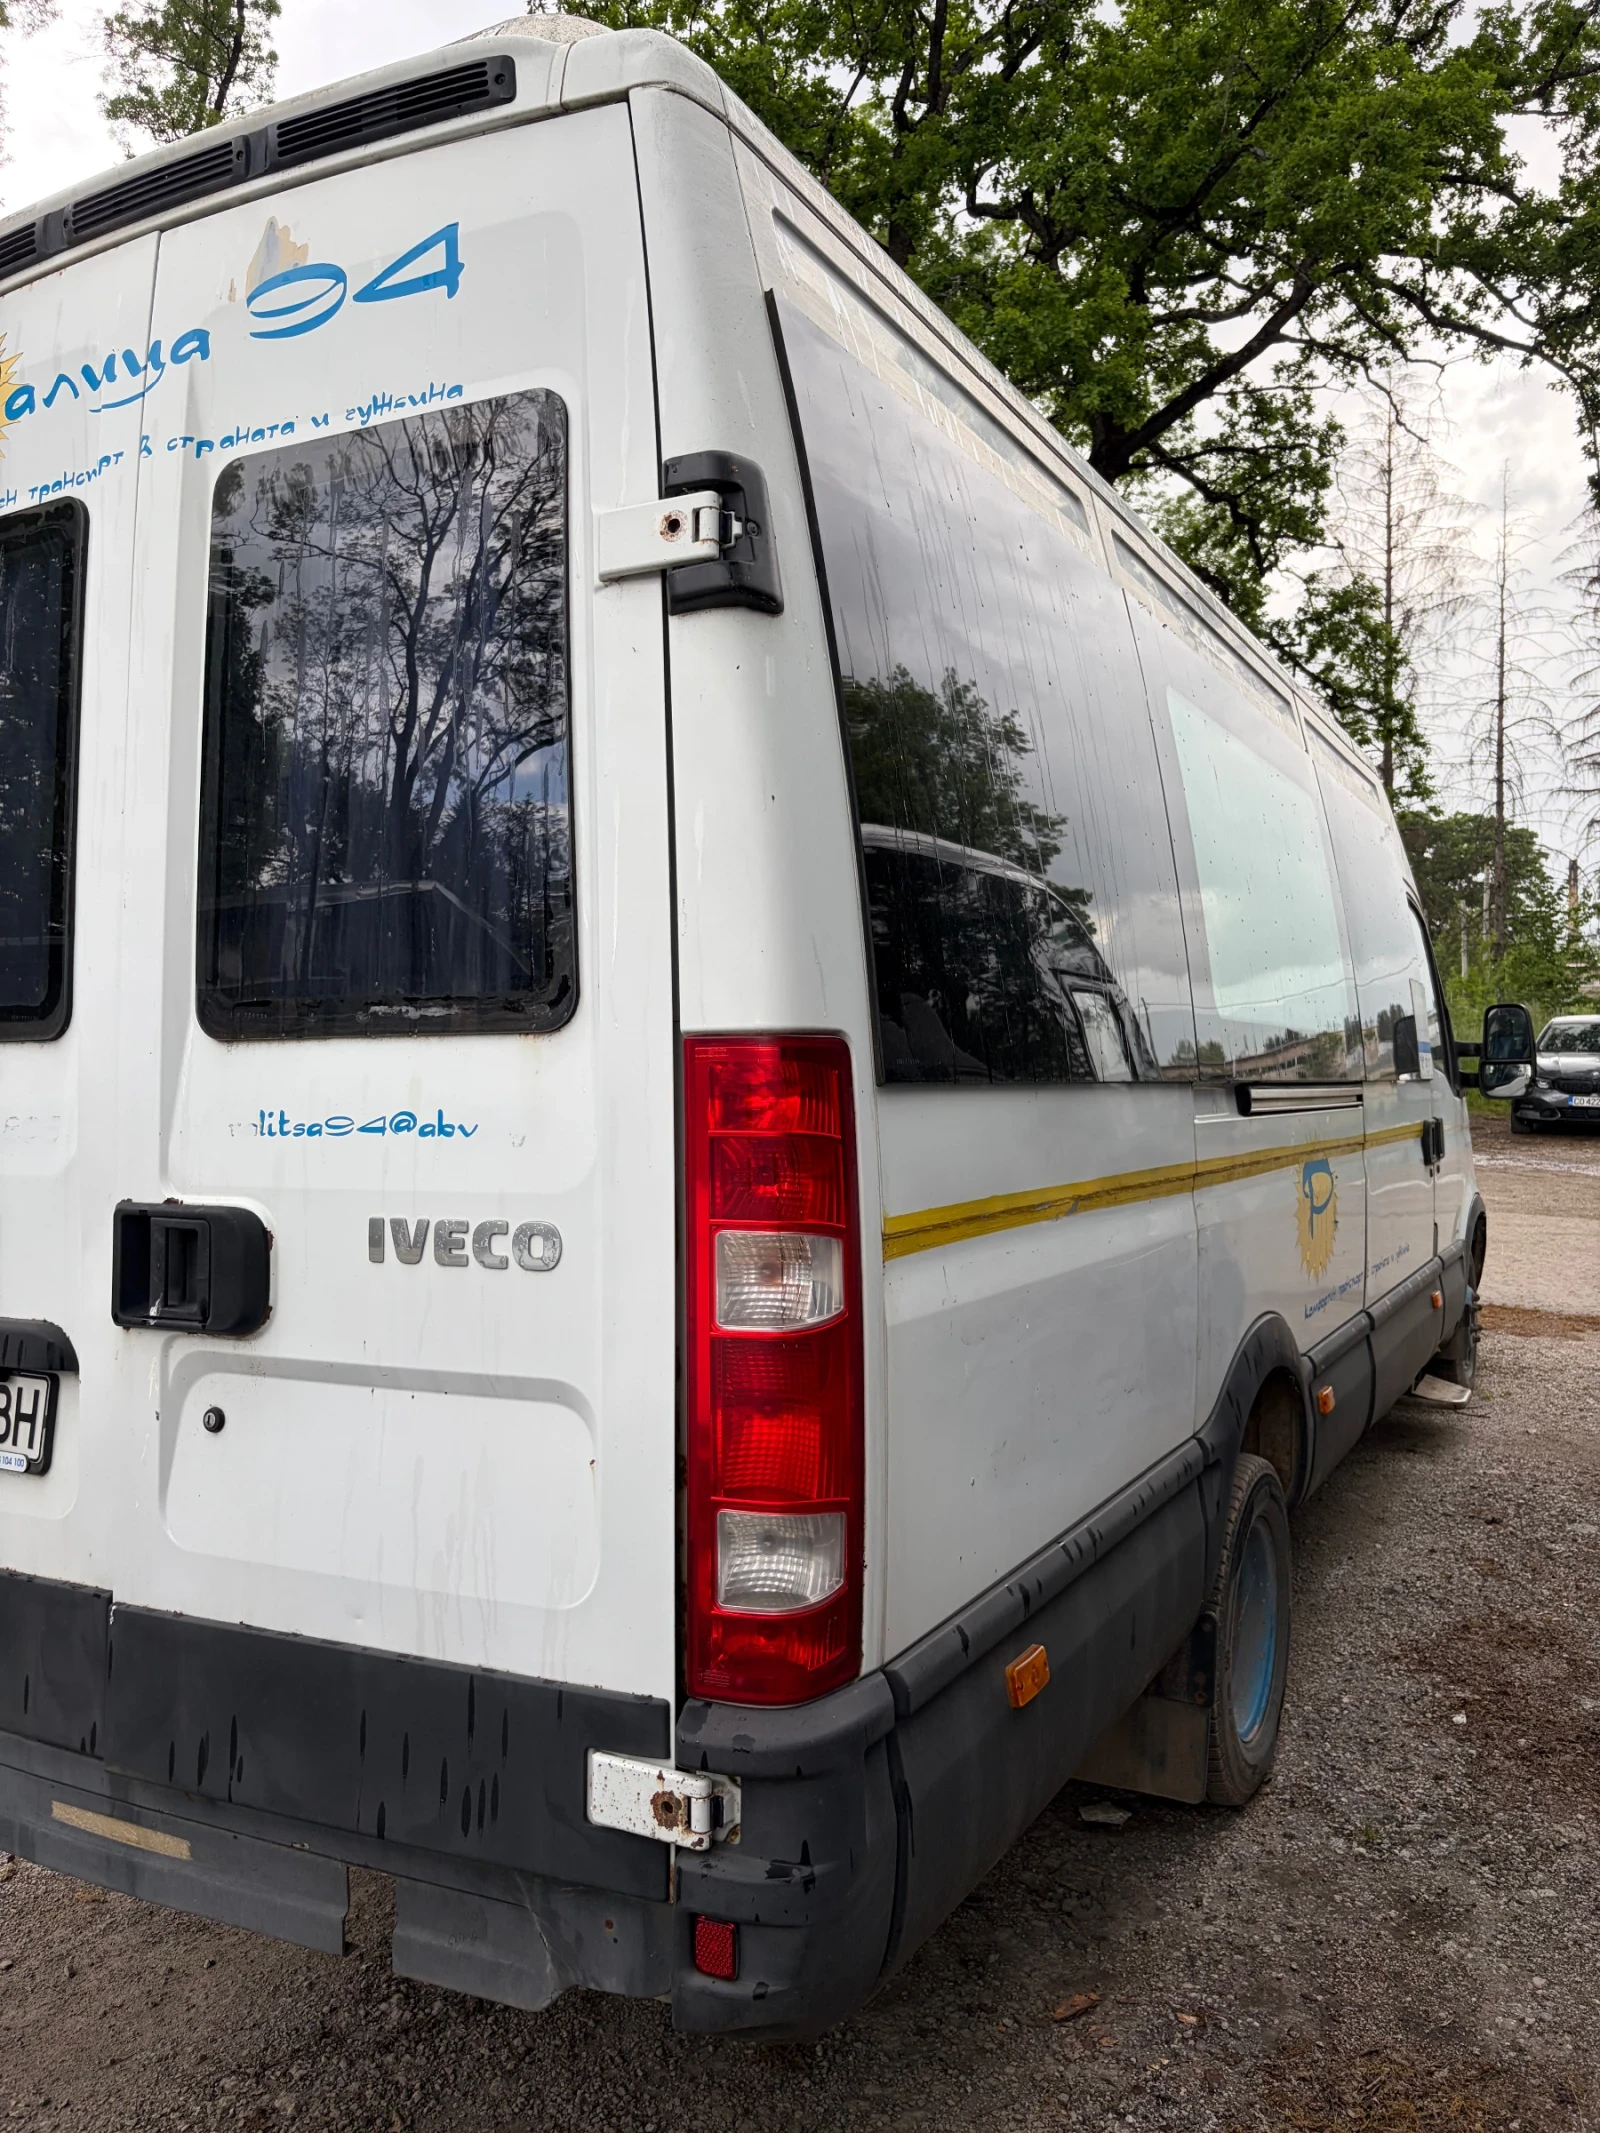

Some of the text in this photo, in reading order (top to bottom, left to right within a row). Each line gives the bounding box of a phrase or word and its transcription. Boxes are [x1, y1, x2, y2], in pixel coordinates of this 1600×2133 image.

[246, 221, 466, 340] 94
[228, 1108, 479, 1138] litsa94@abv
[367, 1216, 564, 1272] IVECO
